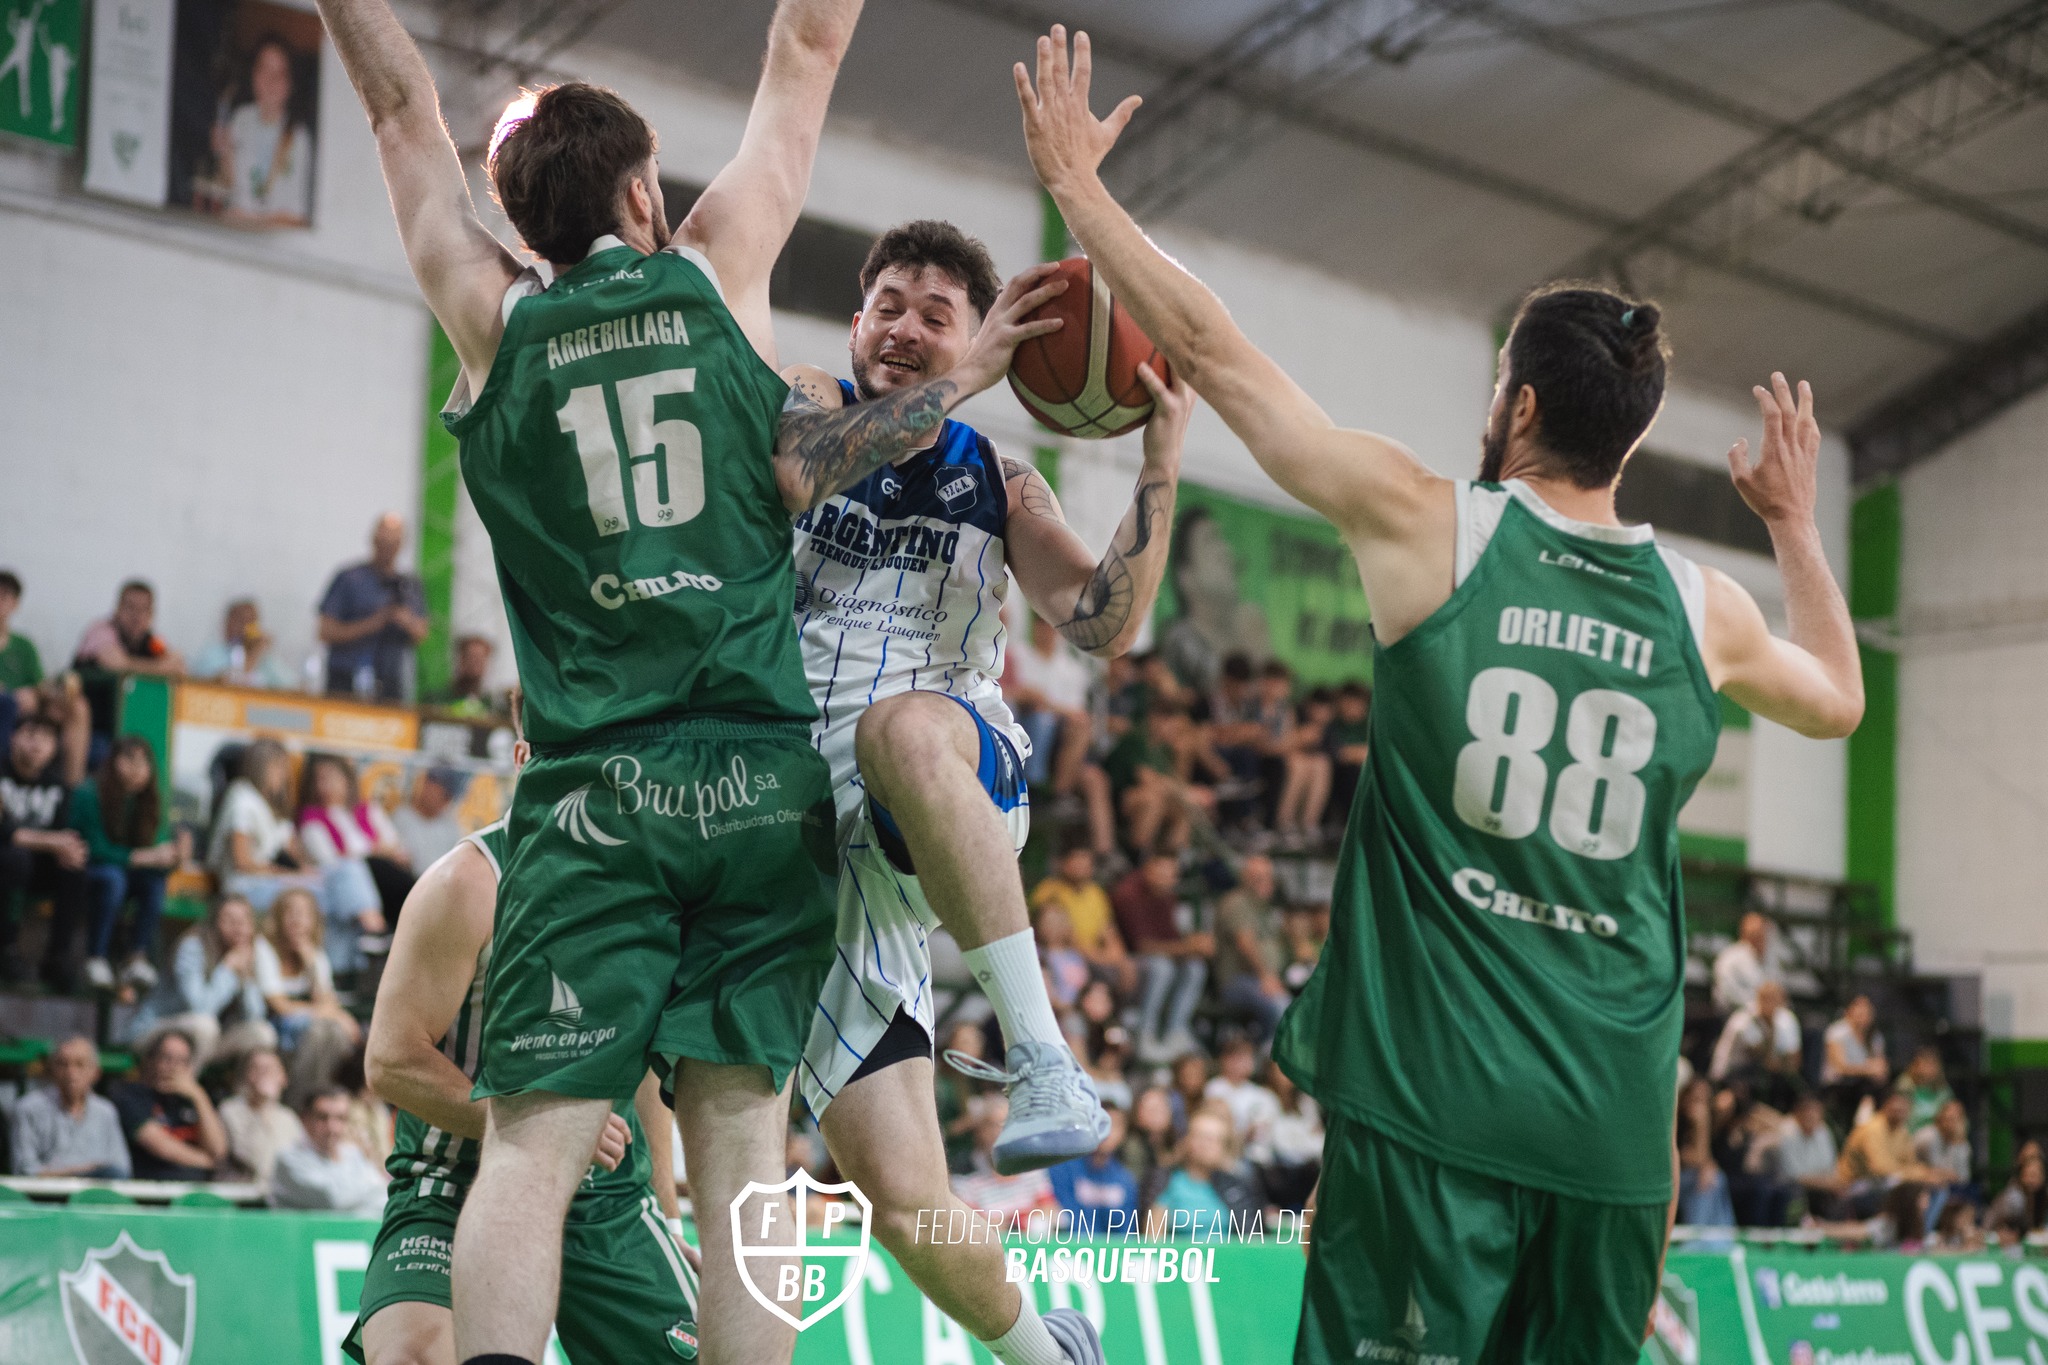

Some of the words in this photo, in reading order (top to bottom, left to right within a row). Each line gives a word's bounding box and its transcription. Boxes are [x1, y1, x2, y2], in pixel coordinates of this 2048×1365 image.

[547, 311, 691, 370] ARREBILLAGA
[556, 368, 706, 537] 15
[794, 503, 960, 565] ARGENTINO
[810, 538, 868, 570] TRENQUE
[869, 555, 930, 574] LAUQUEN
[814, 608, 873, 630] Trenque
[875, 621, 941, 642] Lauquen
[819, 586, 948, 623] Diagnóstico
[1497, 606, 1655, 678] ORLIETTI
[1453, 666, 1658, 860] 88
[601, 755, 760, 840] Brupal
[709, 815, 775, 838] Distribuidora
[577, 1026, 616, 1049] popa
